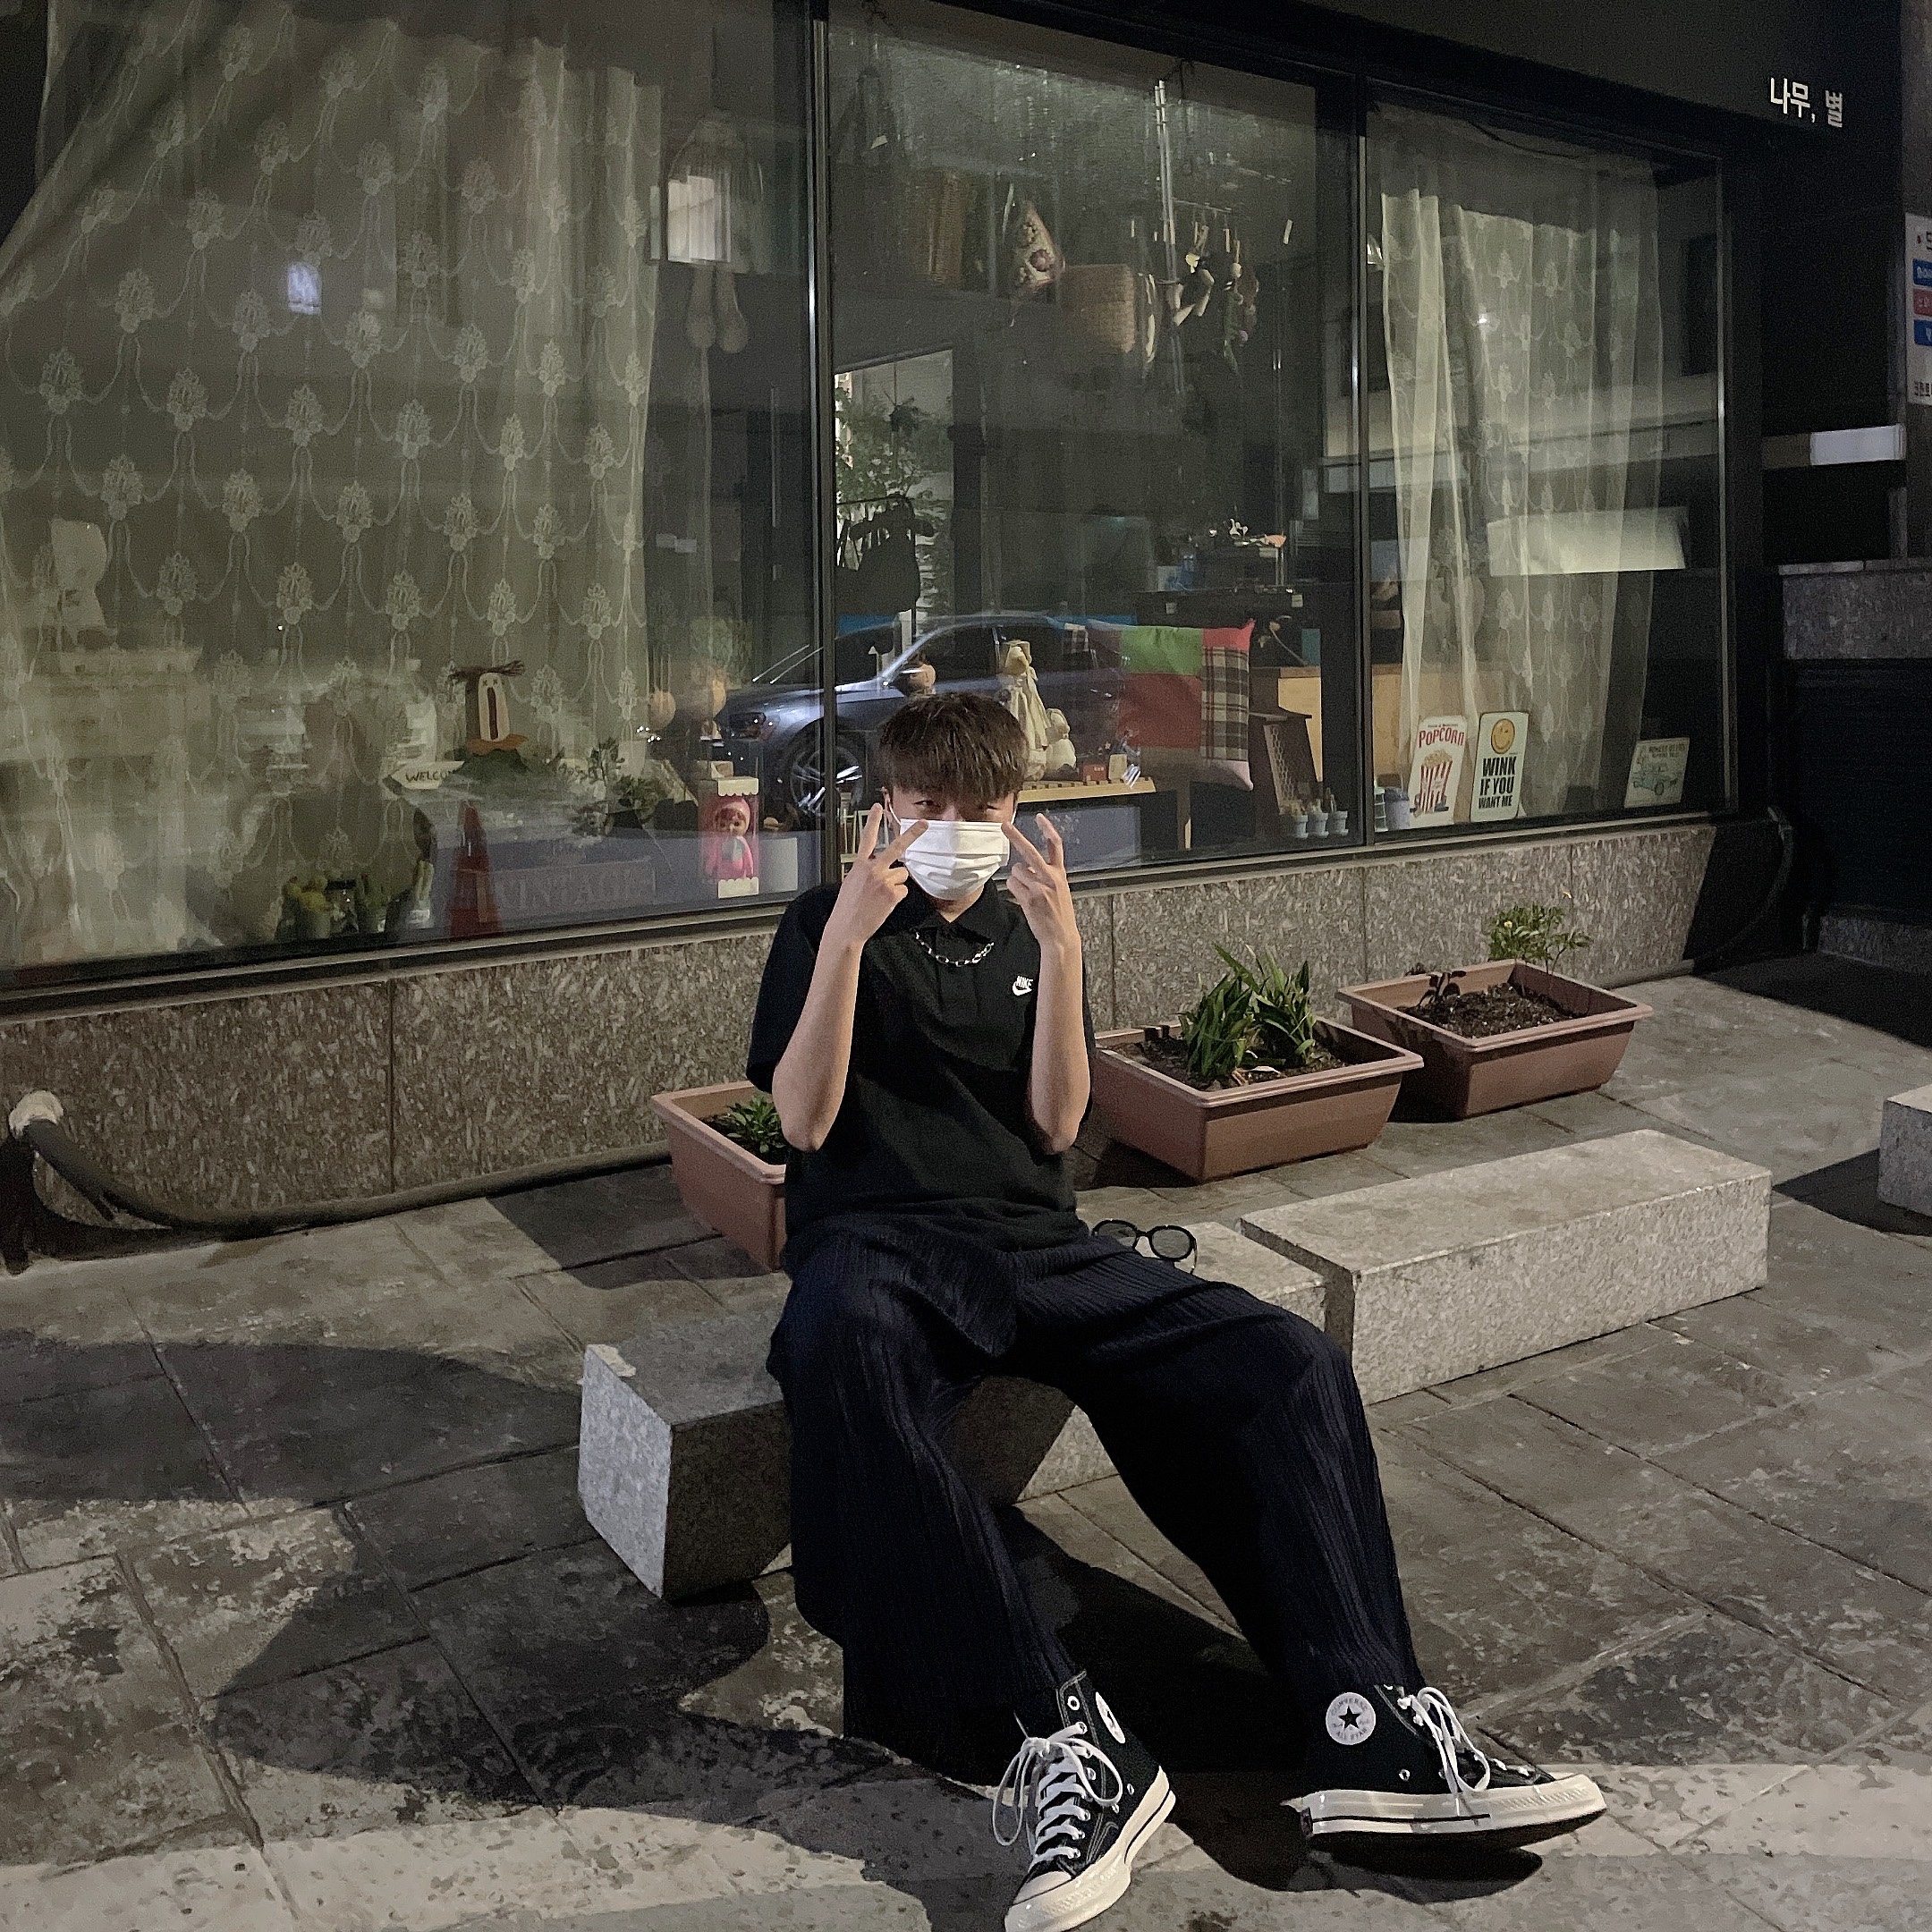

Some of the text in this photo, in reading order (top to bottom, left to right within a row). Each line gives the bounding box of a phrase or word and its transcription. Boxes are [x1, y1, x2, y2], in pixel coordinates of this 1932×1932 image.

[1419, 725, 1465, 748] POPCORN
[404, 769, 452, 784] WELCO
[1482, 756, 1517, 777] WINK
[1479, 775, 1515, 796] IF YOU
[1478, 794, 1513, 809] WANT ME
